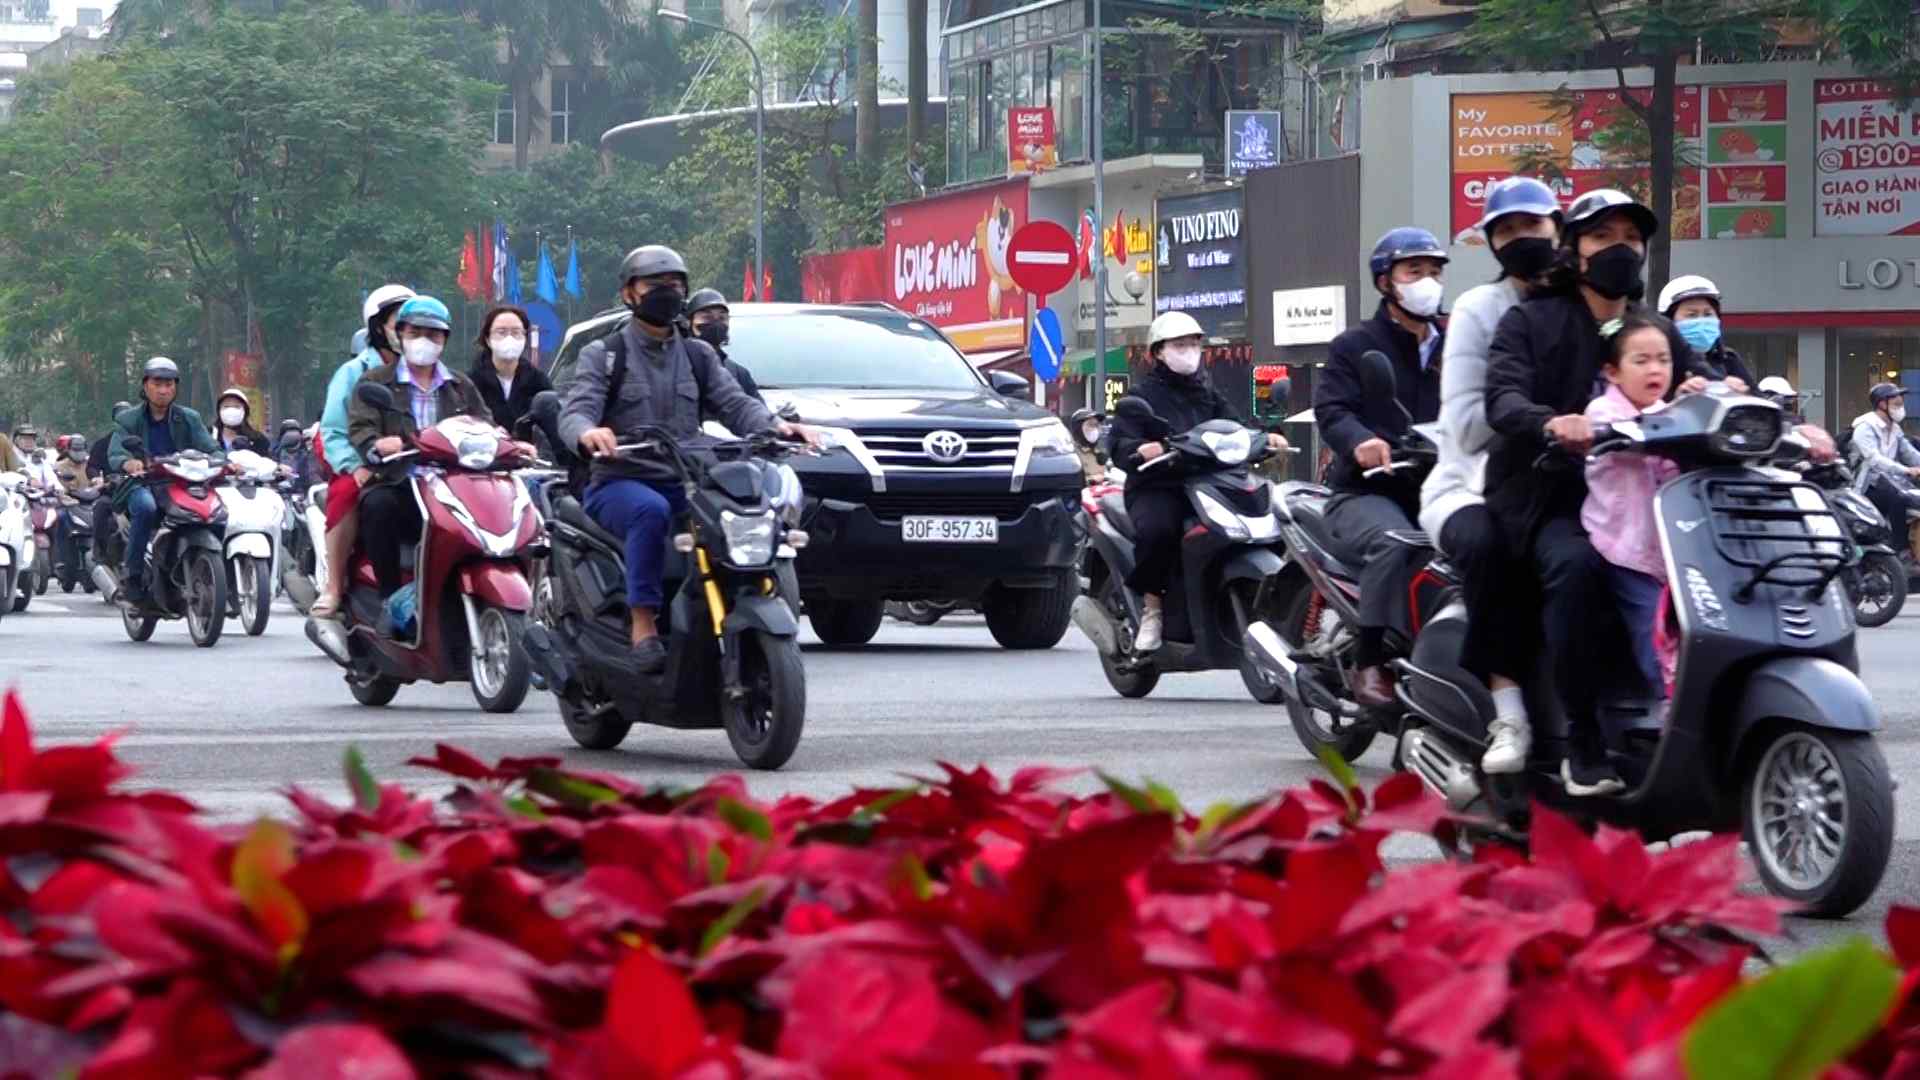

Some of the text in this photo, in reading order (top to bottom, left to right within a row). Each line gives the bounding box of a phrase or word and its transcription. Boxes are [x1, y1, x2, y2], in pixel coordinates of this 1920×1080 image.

[1458, 109, 1487, 123] My
[1821, 104, 1900, 141] MIỄN
[1822, 178, 1870, 196] GIAO
[1822, 198, 1861, 219] TẬN
[1172, 214, 1205, 244] VINO
[1206, 209, 1239, 240] FINO
[894, 239, 935, 301] LOVE
